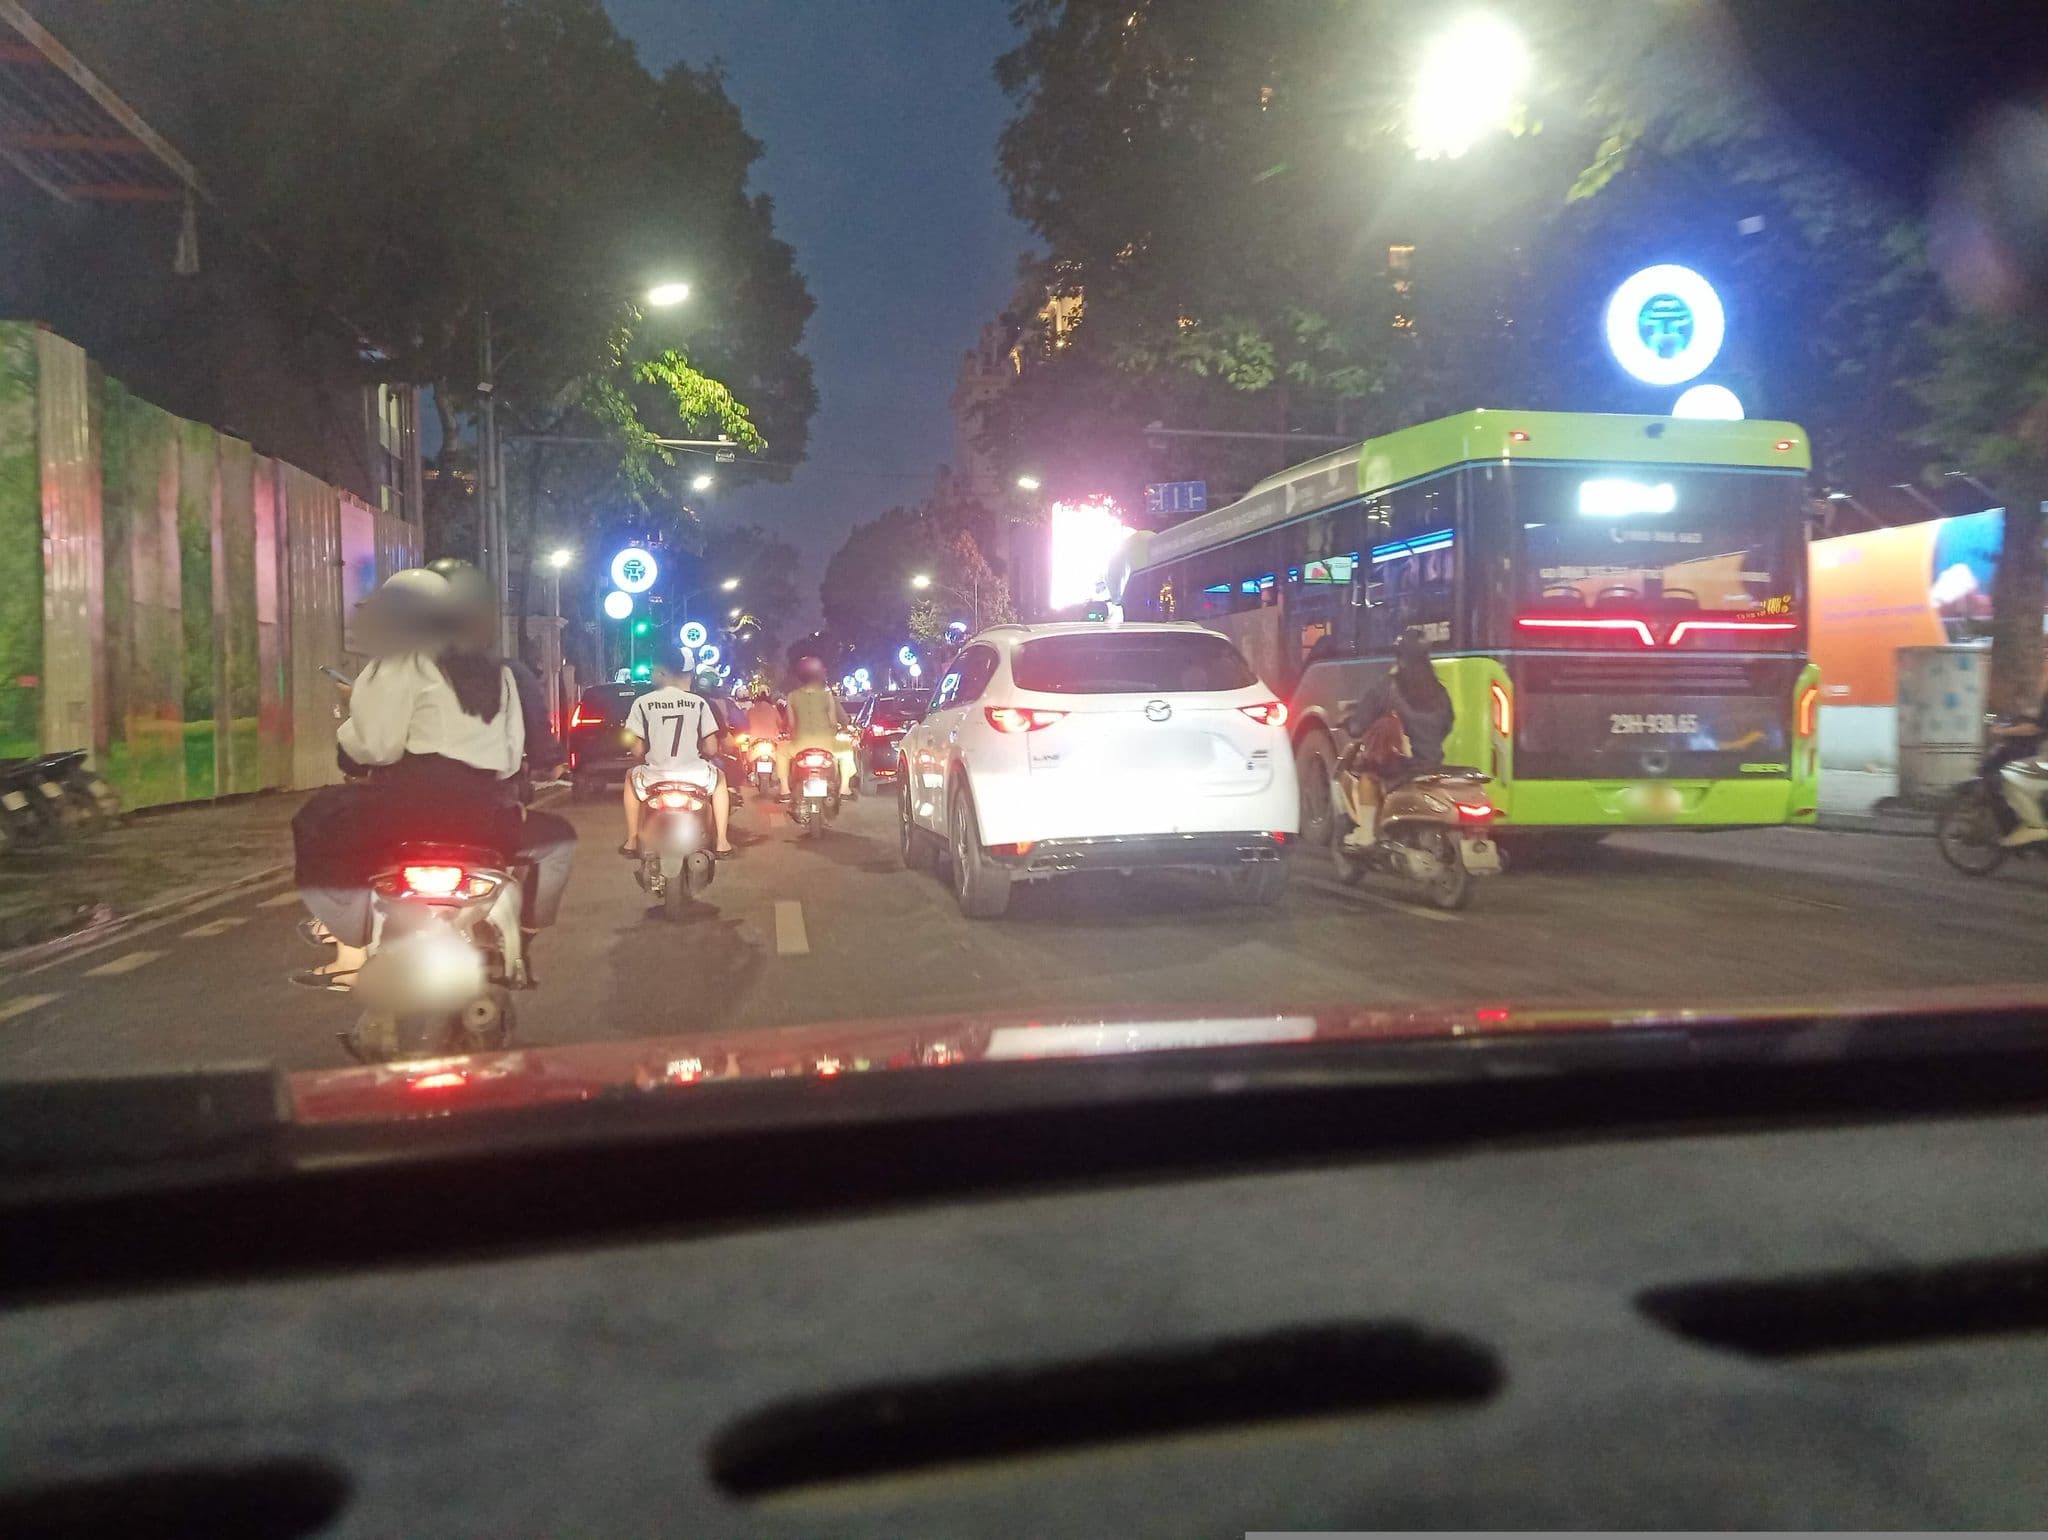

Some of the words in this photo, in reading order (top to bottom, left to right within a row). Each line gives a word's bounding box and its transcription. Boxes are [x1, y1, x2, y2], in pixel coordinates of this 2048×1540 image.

[647, 701, 674, 711] Phan
[677, 699, 696, 709] Huy
[661, 714, 684, 757] 7
